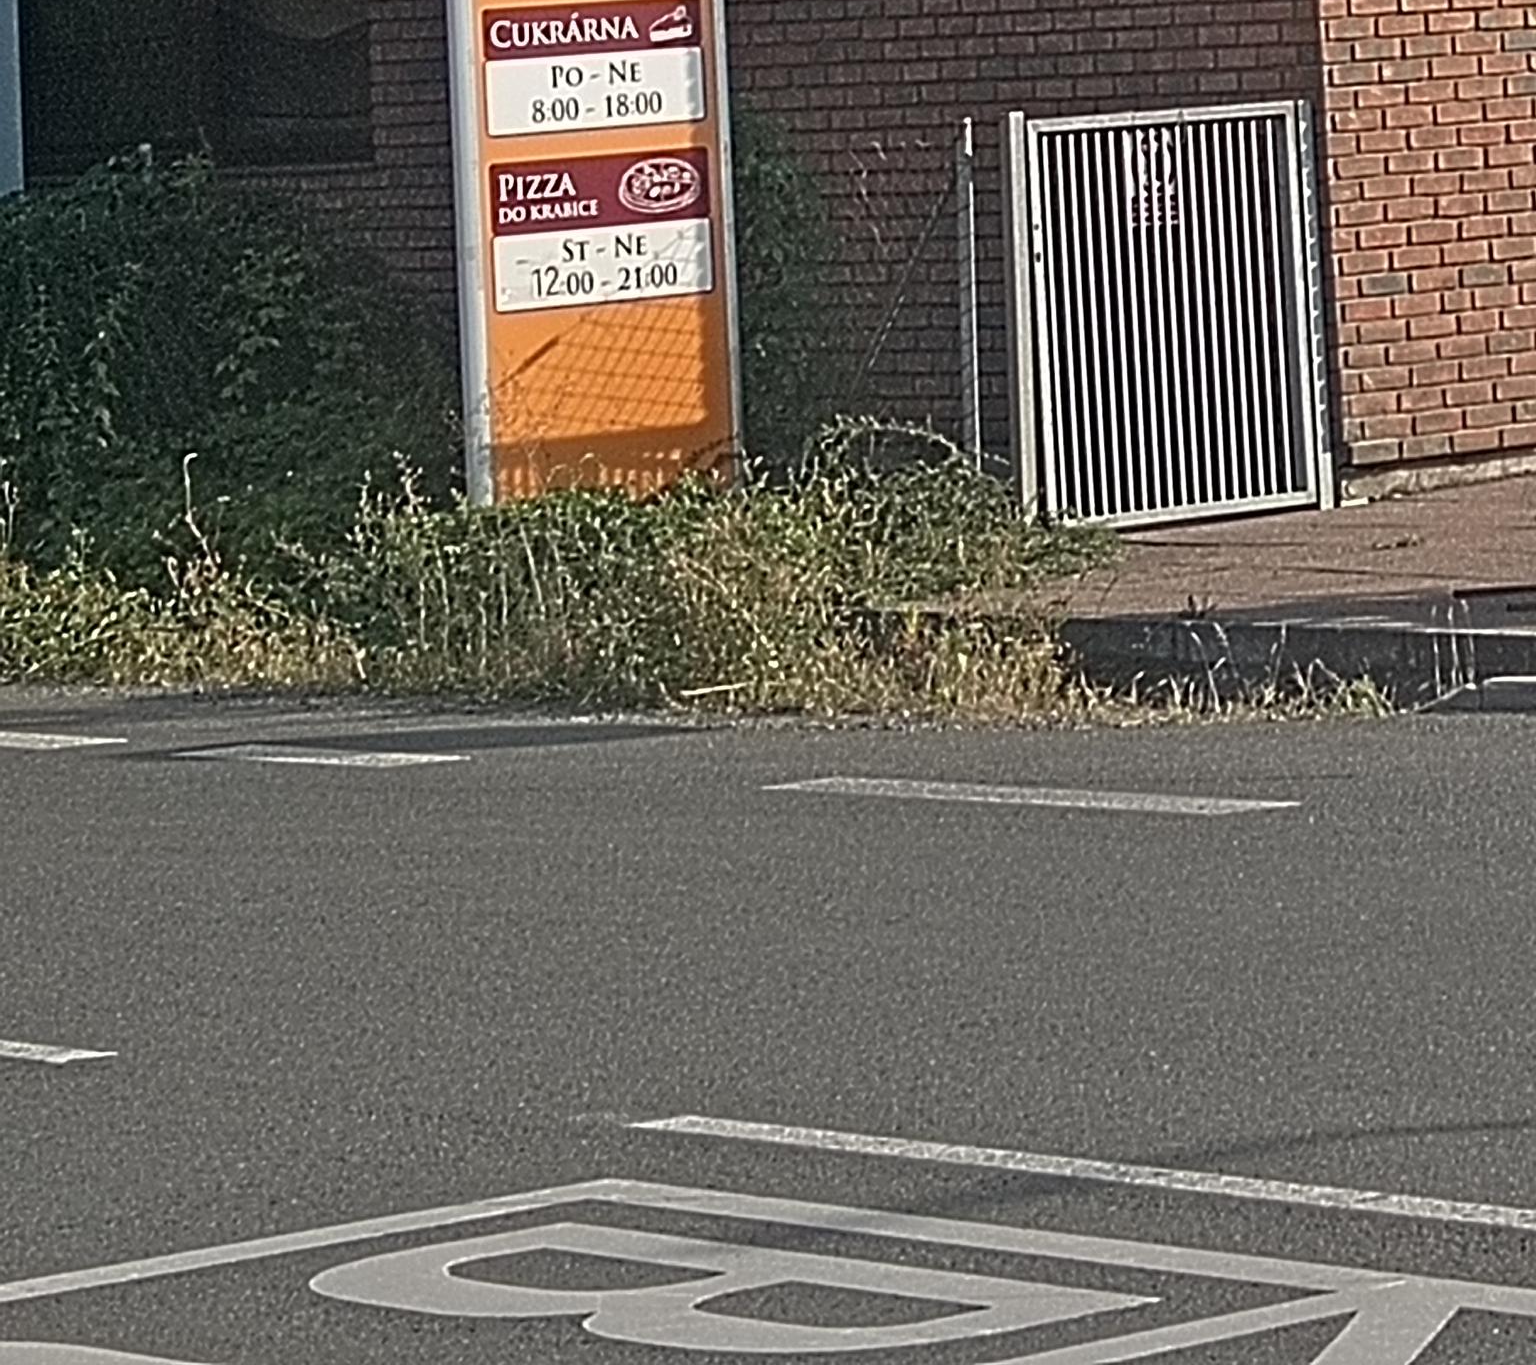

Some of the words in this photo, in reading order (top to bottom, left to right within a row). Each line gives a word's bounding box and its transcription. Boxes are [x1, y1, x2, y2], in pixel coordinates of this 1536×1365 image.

[489, 12, 640, 49] CUKRÁRNA
[531, 97, 580, 123] 8:00
[604, 91, 663, 119] 18:00
[498, 173, 577, 202] PIZZA
[498, 206, 526, 224] DO
[530, 199, 599, 221] KRABICE
[531, 265, 594, 298] 12:00
